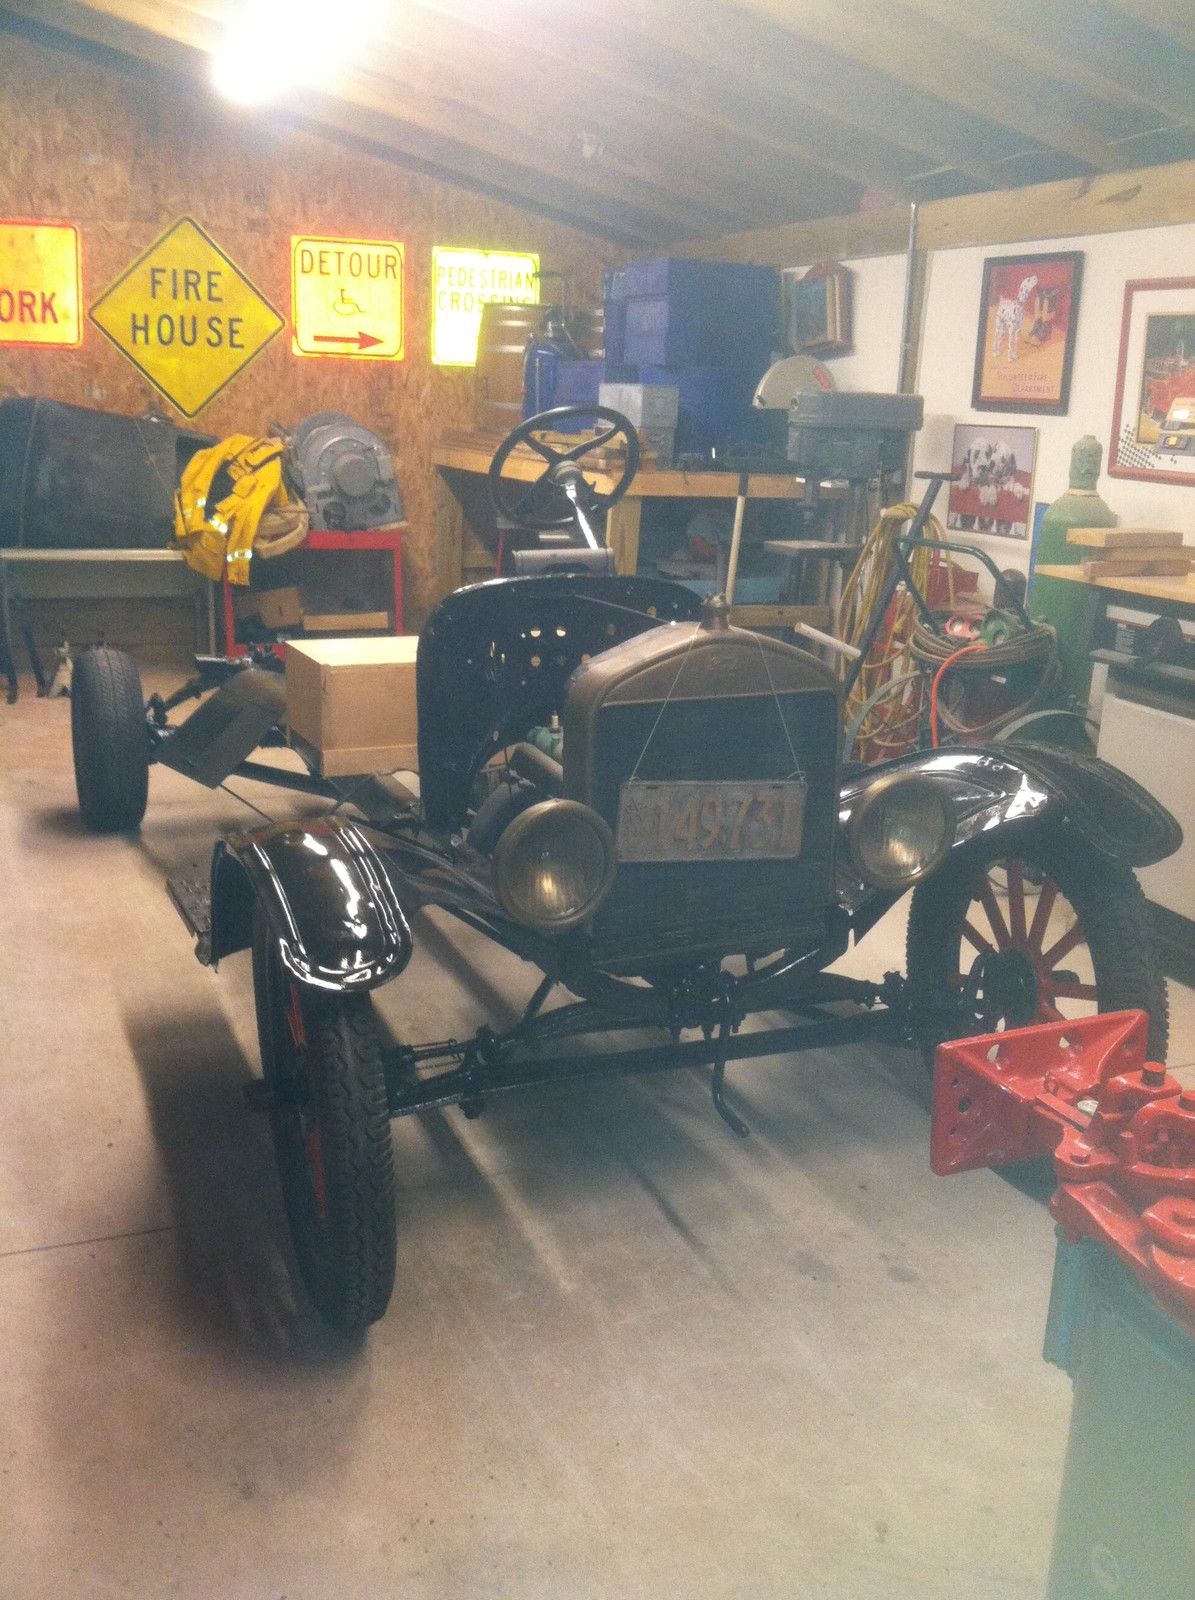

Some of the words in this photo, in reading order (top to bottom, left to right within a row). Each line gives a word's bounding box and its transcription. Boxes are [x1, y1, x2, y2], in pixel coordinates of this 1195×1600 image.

[300, 249, 398, 280] DETOUR
[438, 266, 534, 289] PEDESTRIAN
[150, 268, 223, 303] FIRE
[130, 313, 245, 349] HOUSE
